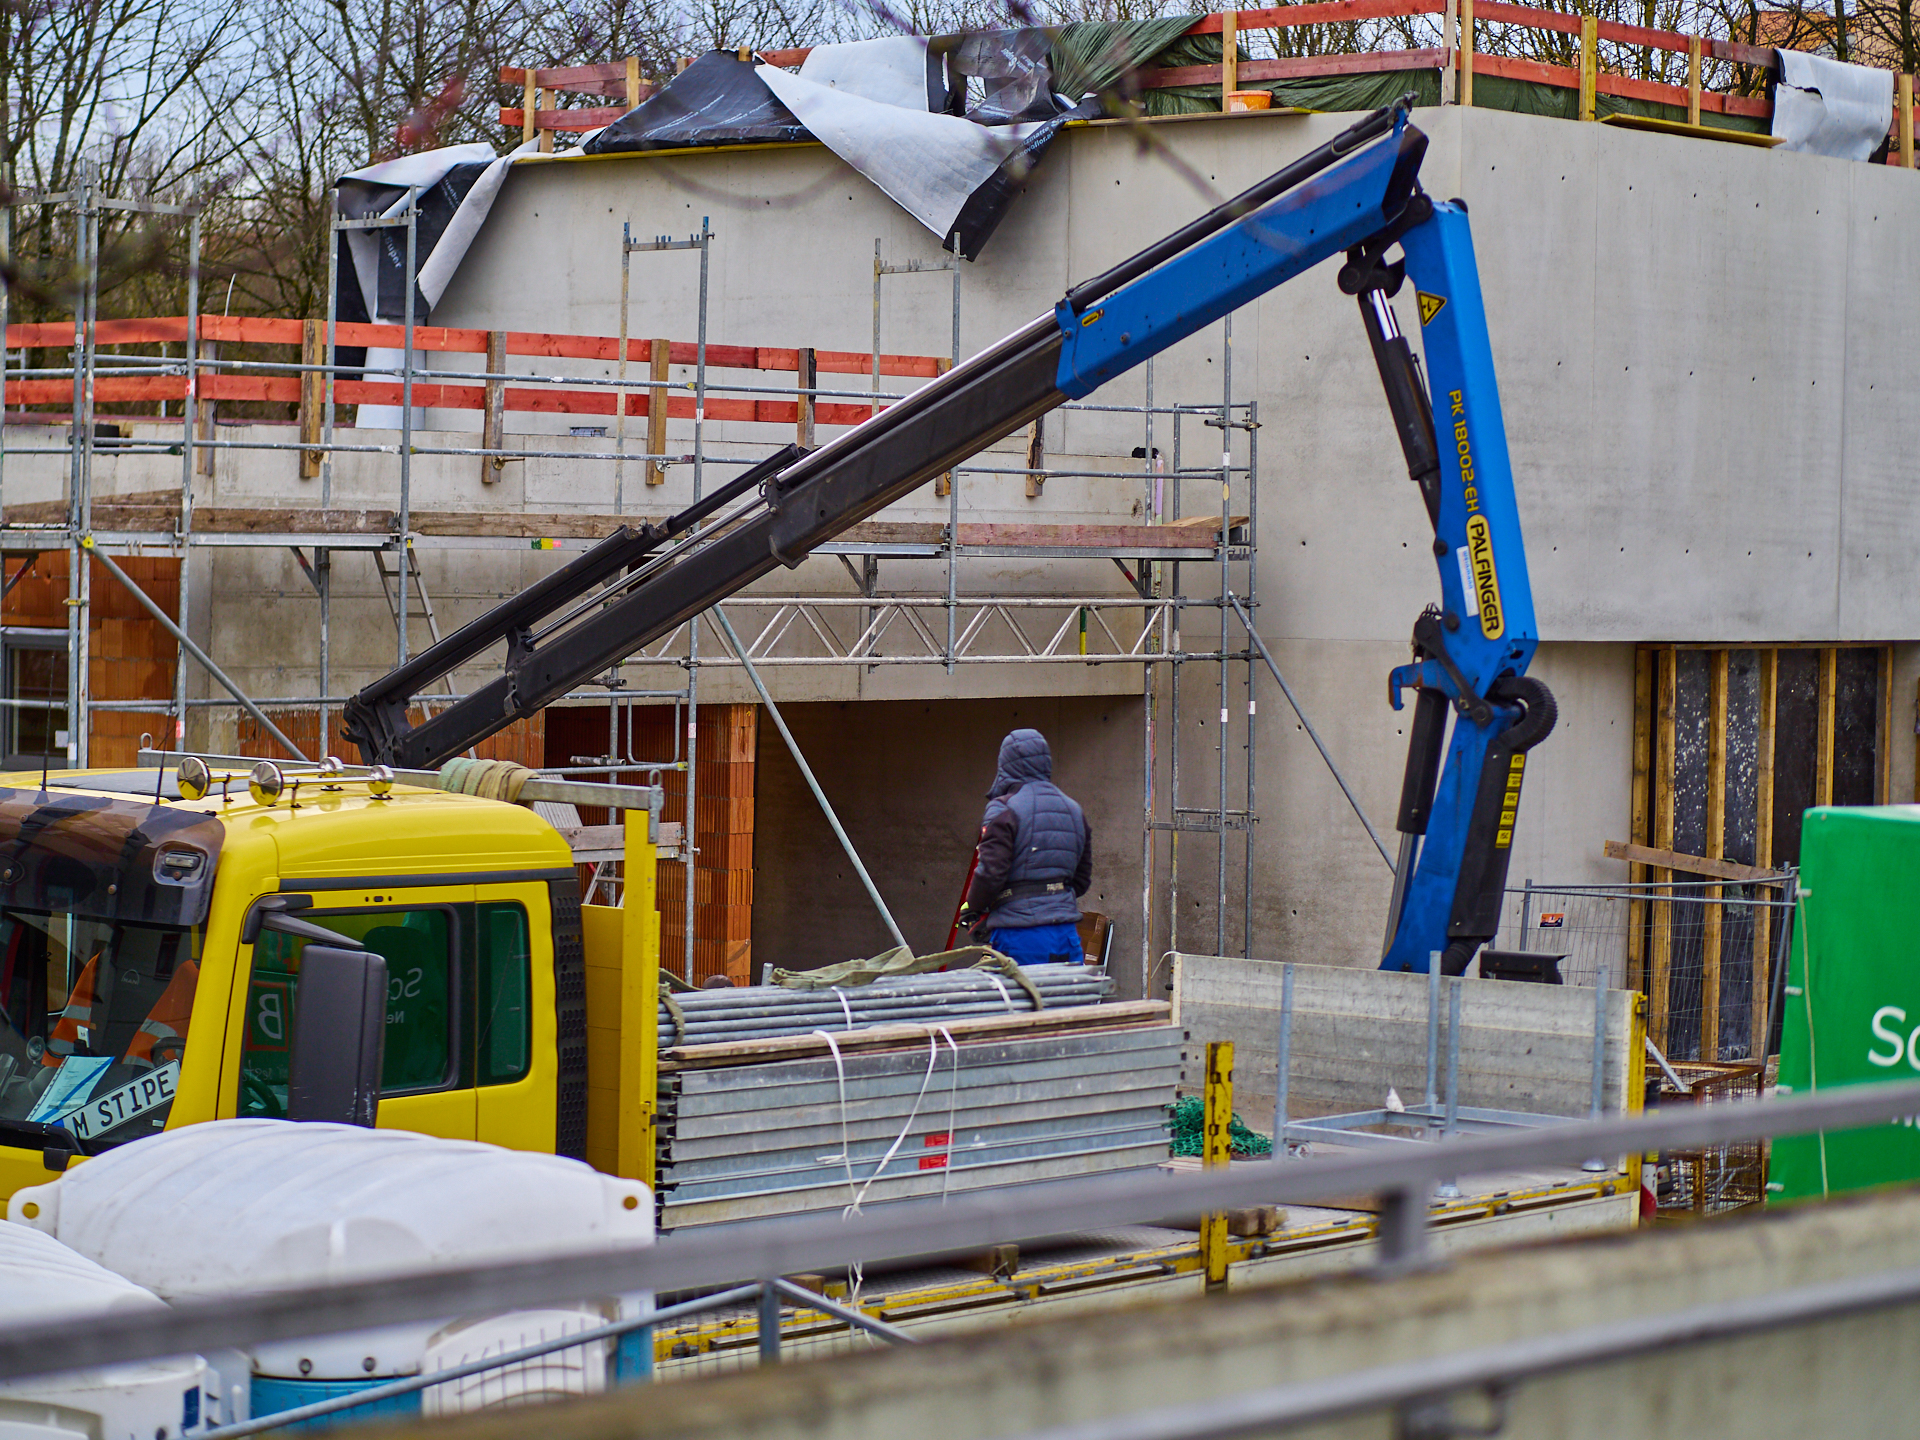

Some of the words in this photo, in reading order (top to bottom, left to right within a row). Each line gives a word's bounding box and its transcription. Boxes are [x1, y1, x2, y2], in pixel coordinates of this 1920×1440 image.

[1448, 389, 1464, 415] PK
[1470, 522, 1500, 633] PALFINGER
[72, 1111, 90, 1137] M
[97, 1069, 175, 1128] STIPE
